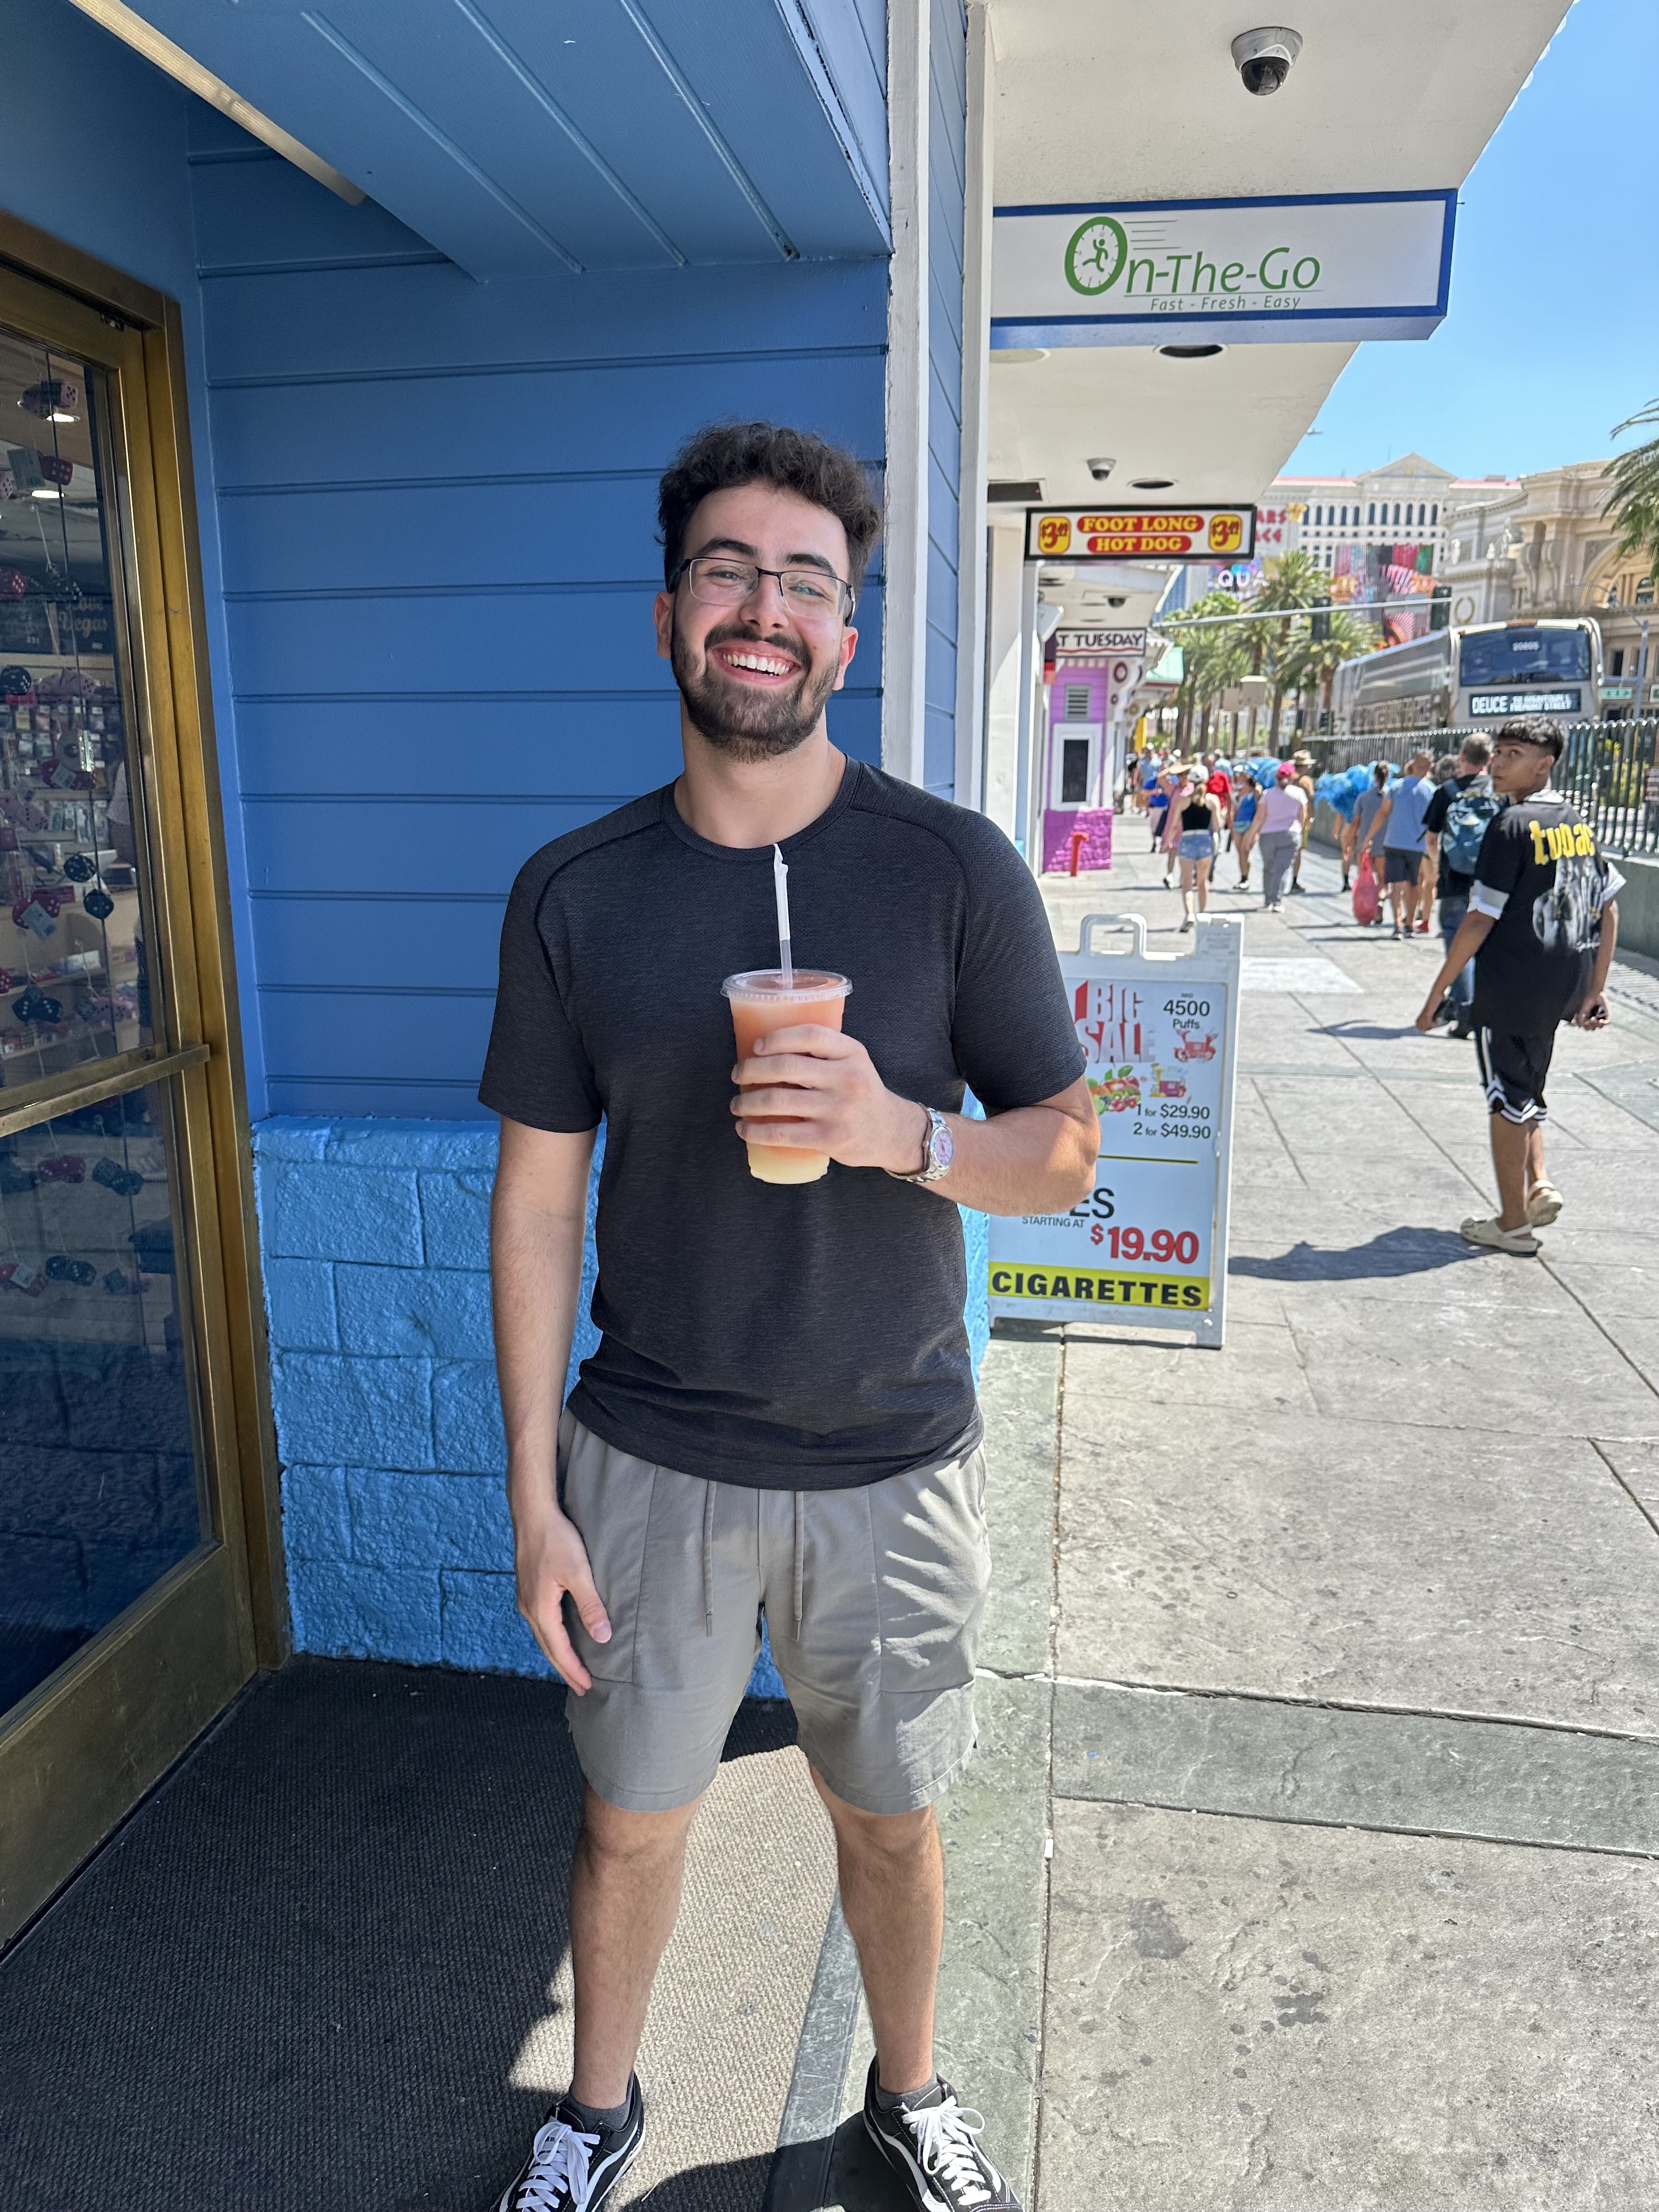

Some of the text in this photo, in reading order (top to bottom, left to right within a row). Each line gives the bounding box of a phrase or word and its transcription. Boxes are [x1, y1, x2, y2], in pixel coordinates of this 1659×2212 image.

[1064, 216, 1320, 296] On-The-Go
[1150, 298, 1183, 311] Fast
[1201, 296, 1246, 310] Fresh
[1263, 296, 1300, 310] Easy
[1082, 516, 1198, 532] FOOT LONG
[1096, 537, 1182, 552] HOT DOG
[1056, 633, 1143, 647] T TUESDAY
[1472, 695, 1508, 714] DEUCE
[1077, 980, 1144, 1022] BIG
[1163, 1000, 1210, 1017] 4500
[1172, 1018, 1200, 1029] Puffs
[1075, 1018, 1156, 1063] SALE
[1137, 1103, 1210, 1120] 1 for $29.90
[1133, 1122, 1211, 1139] 2 for $49.90
[1022, 1216, 1086, 1228] STARTING AT
[991, 1271, 1202, 1307] CIGARETTES
